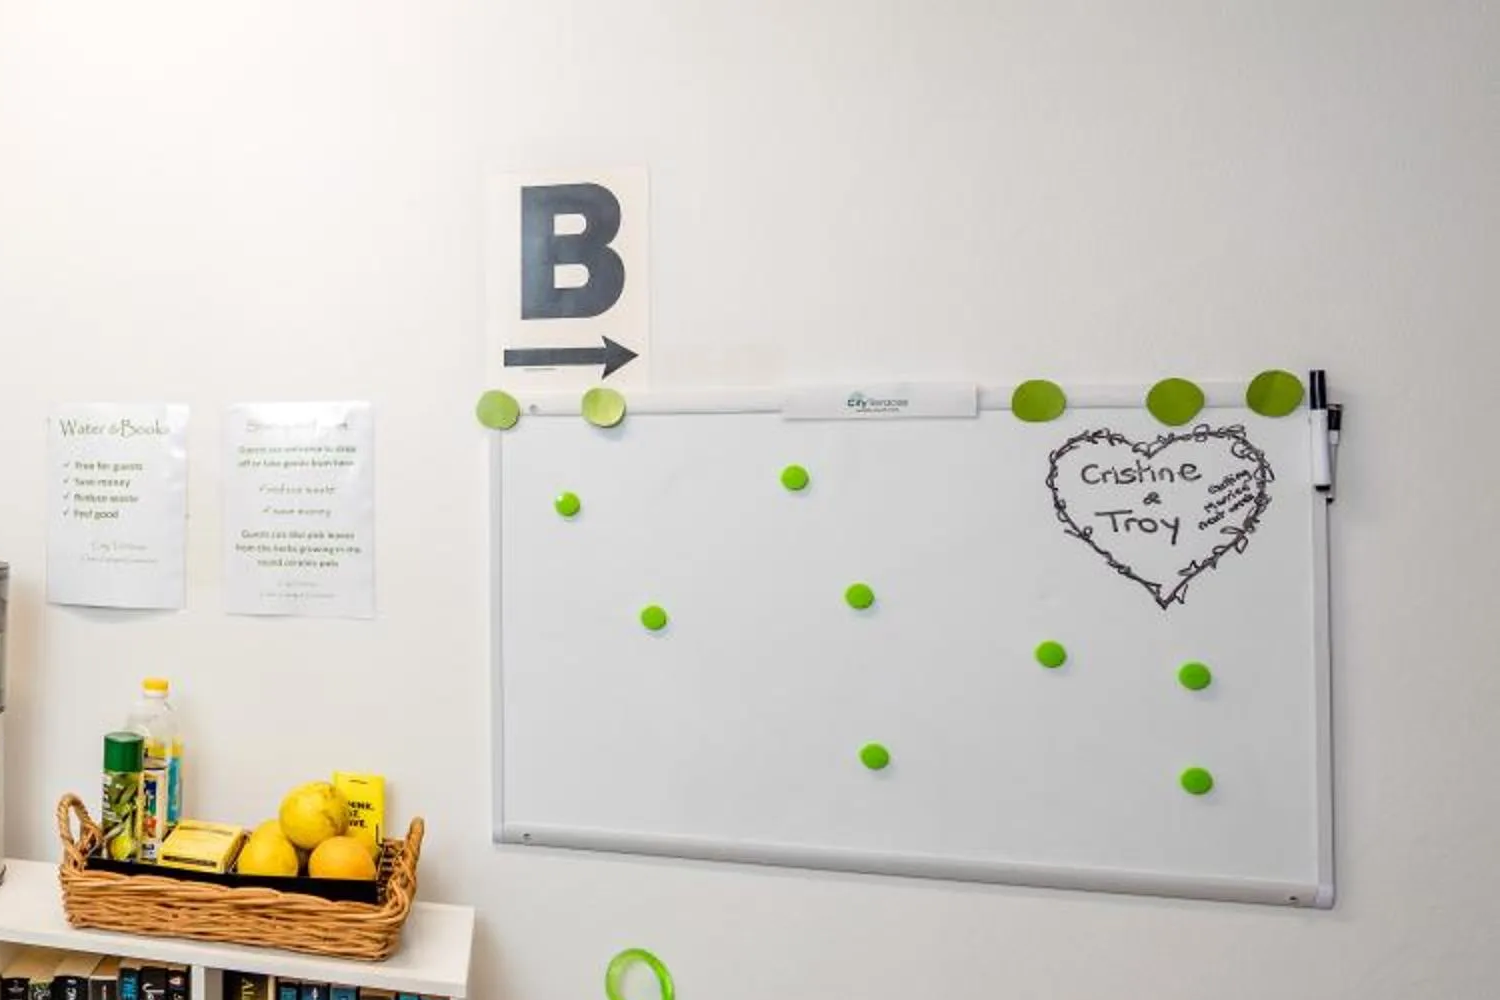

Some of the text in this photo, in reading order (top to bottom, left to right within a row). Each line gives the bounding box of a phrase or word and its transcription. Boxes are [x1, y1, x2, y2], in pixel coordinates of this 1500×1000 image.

[520, 182, 625, 320] B
[59, 418, 105, 437] Water
[1080, 460, 1202, 485] Cristine
[1094, 510, 1181, 546] Troy
[122, 977, 136, 1000] THE
